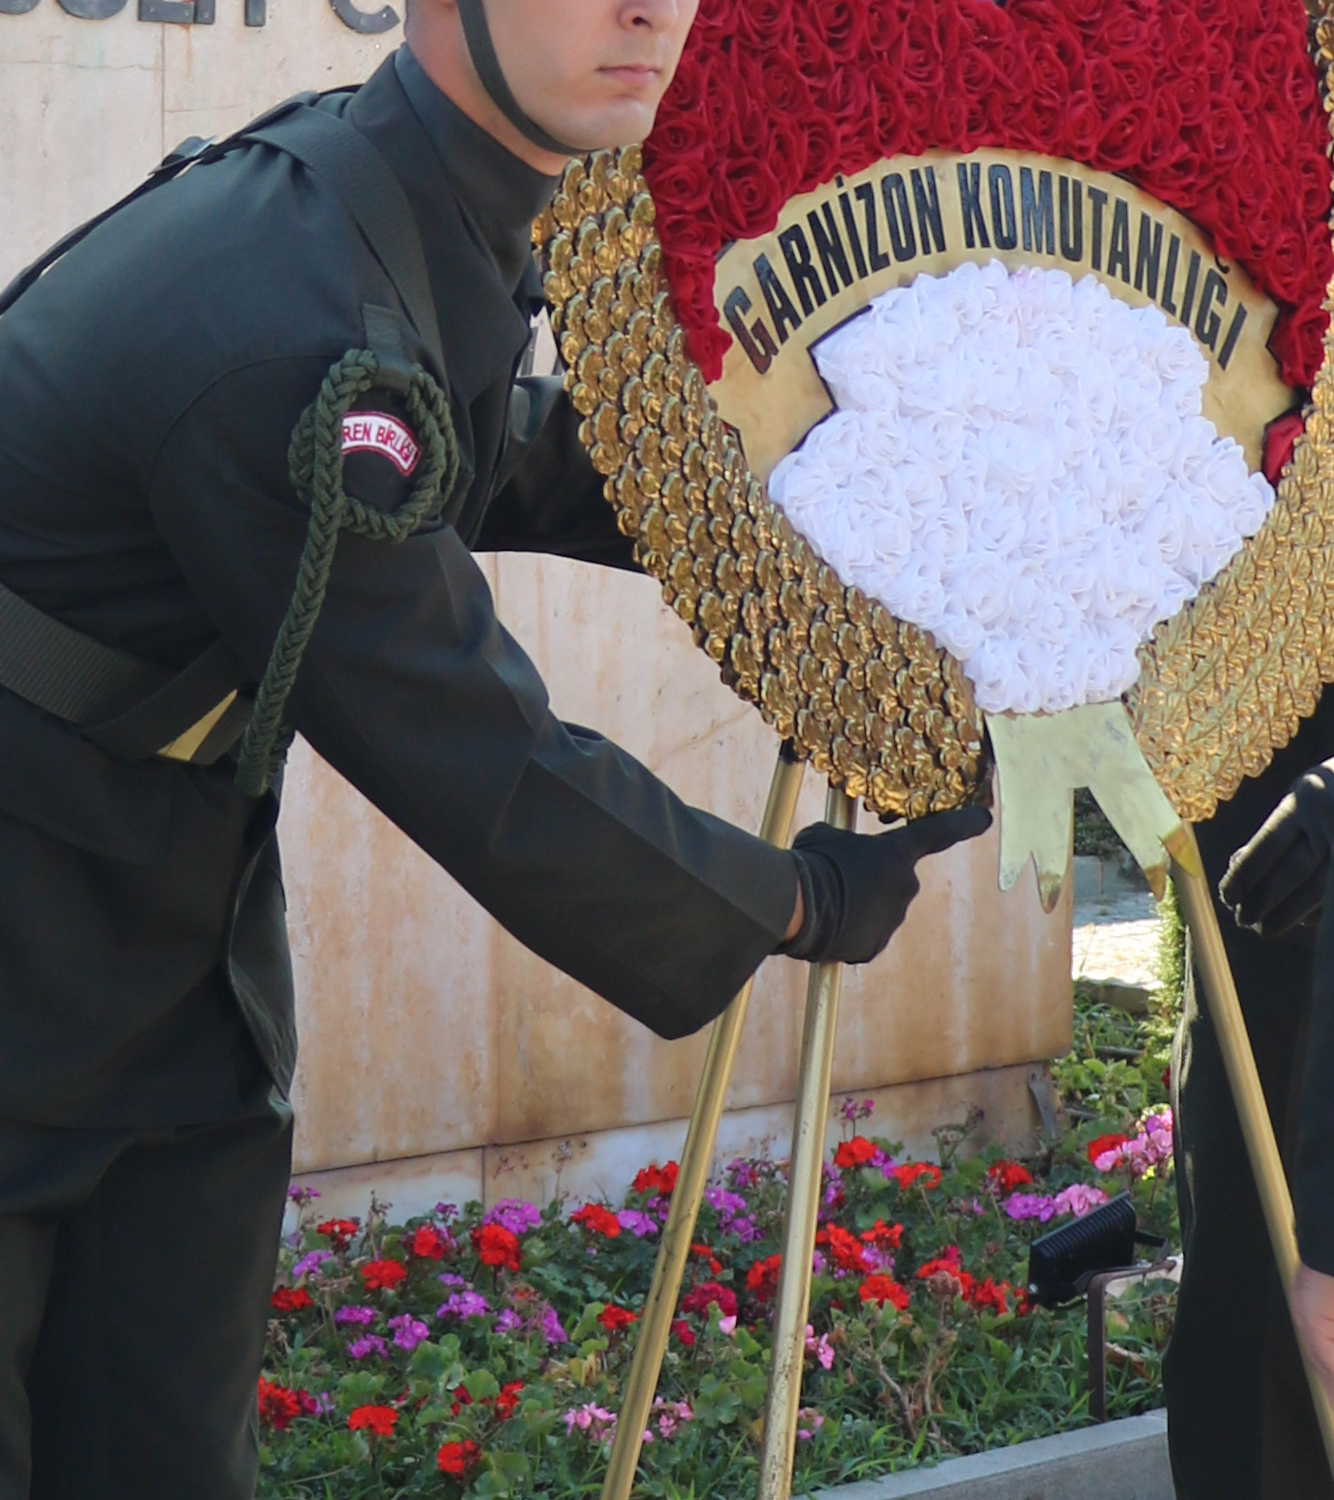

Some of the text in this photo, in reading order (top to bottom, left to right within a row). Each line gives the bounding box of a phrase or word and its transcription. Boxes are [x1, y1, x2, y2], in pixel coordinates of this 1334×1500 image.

[723, 162, 1248, 375] GARNİZON KOMUTANLIĞI
[342, 422, 371, 443] REN
